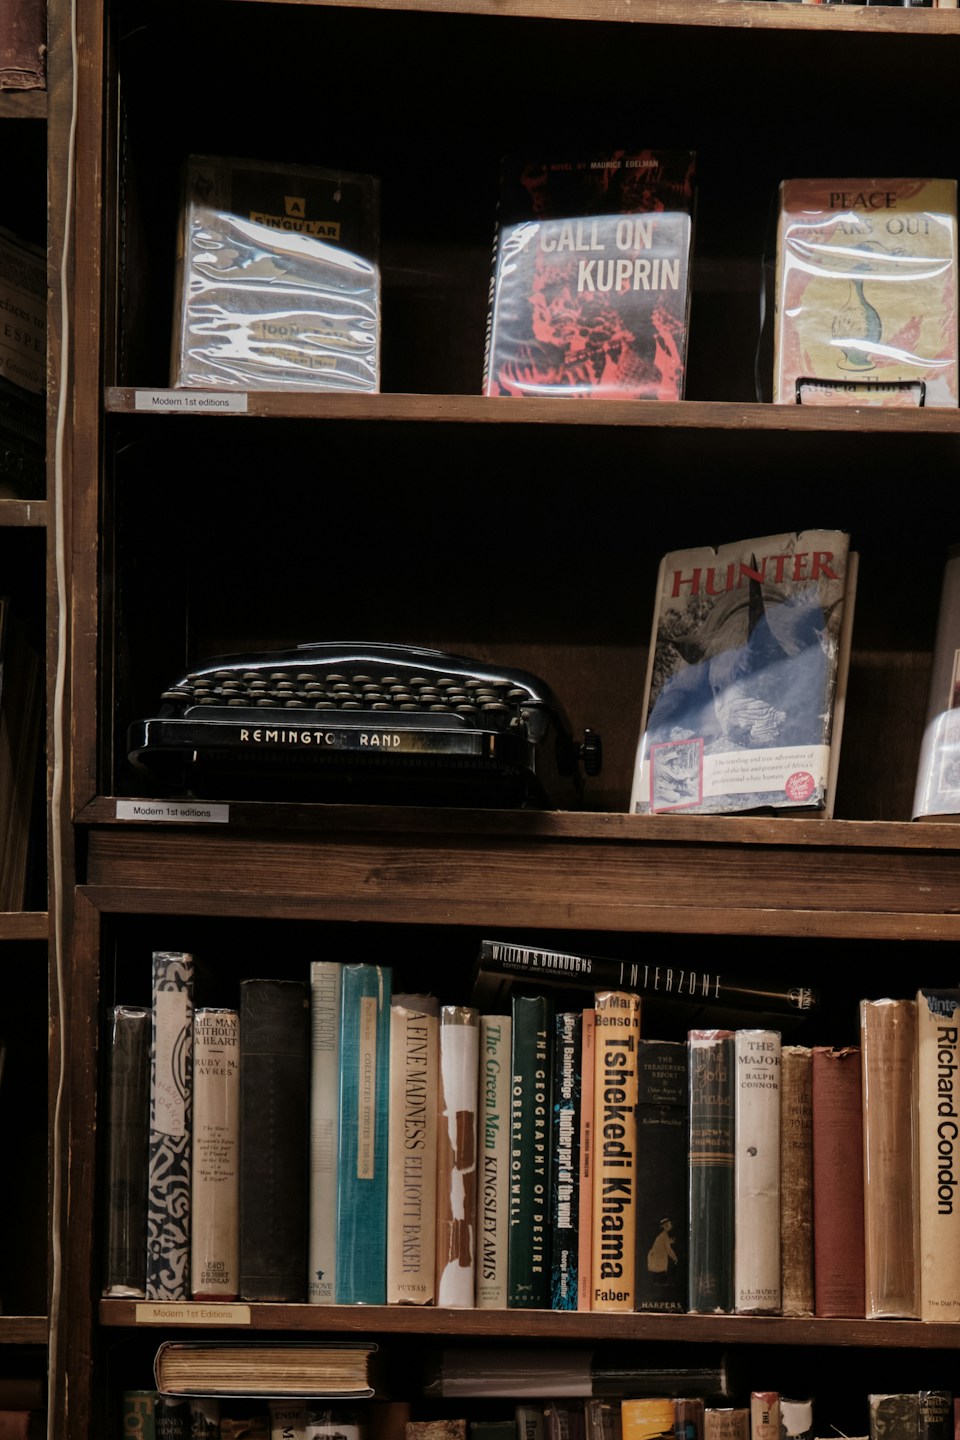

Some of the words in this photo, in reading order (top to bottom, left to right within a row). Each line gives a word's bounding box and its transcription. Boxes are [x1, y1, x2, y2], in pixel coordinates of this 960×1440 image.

[590, 160, 621, 169] MAURICE
[625, 159, 659, 168] EDELMAN
[291, 202, 300, 212] A
[829, 192, 897, 208] PEACE
[254, 216, 337, 236] SINGULAR
[540, 219, 605, 252] CALL
[615, 219, 654, 250] ON
[886, 218, 931, 235] OUT
[577, 258, 680, 292] KUPRIN
[152, 397, 181, 407] Modern
[185, 398, 196, 406] 1st
[199, 398, 229, 406] editions
[671, 551, 841, 598] HUNTER
[359, 733, 401, 747] RAND
[133, 806, 164, 816] Modern
[166, 807, 178, 816] 1st
[180, 807, 211, 817] editions
[619, 961, 721, 998] INTERZONE
[203, 1038, 237, 1046] HEART
[406, 1025, 427, 1063] FINE
[486, 1026, 501, 1054] The
[537, 1031, 546, 1060] THE
[748, 1042, 774, 1050] THE
[485, 1056, 500, 1110] Green
[936, 1026, 958, 1119] Richard
[405, 1066, 426, 1149] MADNESS
[513, 1076, 522, 1140] ROBERT
[603, 1036, 635, 1167] Tshekedi
[485, 1114, 500, 1150] Man
[535, 1071, 545, 1176] GEOGRAPHY
[936, 1123, 958, 1216] Condon
[483, 1156, 497, 1224] KINGSLEY
[511, 1150, 521, 1226] BOSWELL
[534, 1184, 544, 1205] OF
[532, 1214, 543, 1273] DESIRE
[601, 1178, 632, 1280] Khama
[403, 1224, 421, 1273] BAKER
[482, 1228, 496, 1280] AMIS
[595, 1289, 630, 1302] Faber
[153, 1309, 184, 1318] Modern
[201, 1309, 232, 1319] Editions
